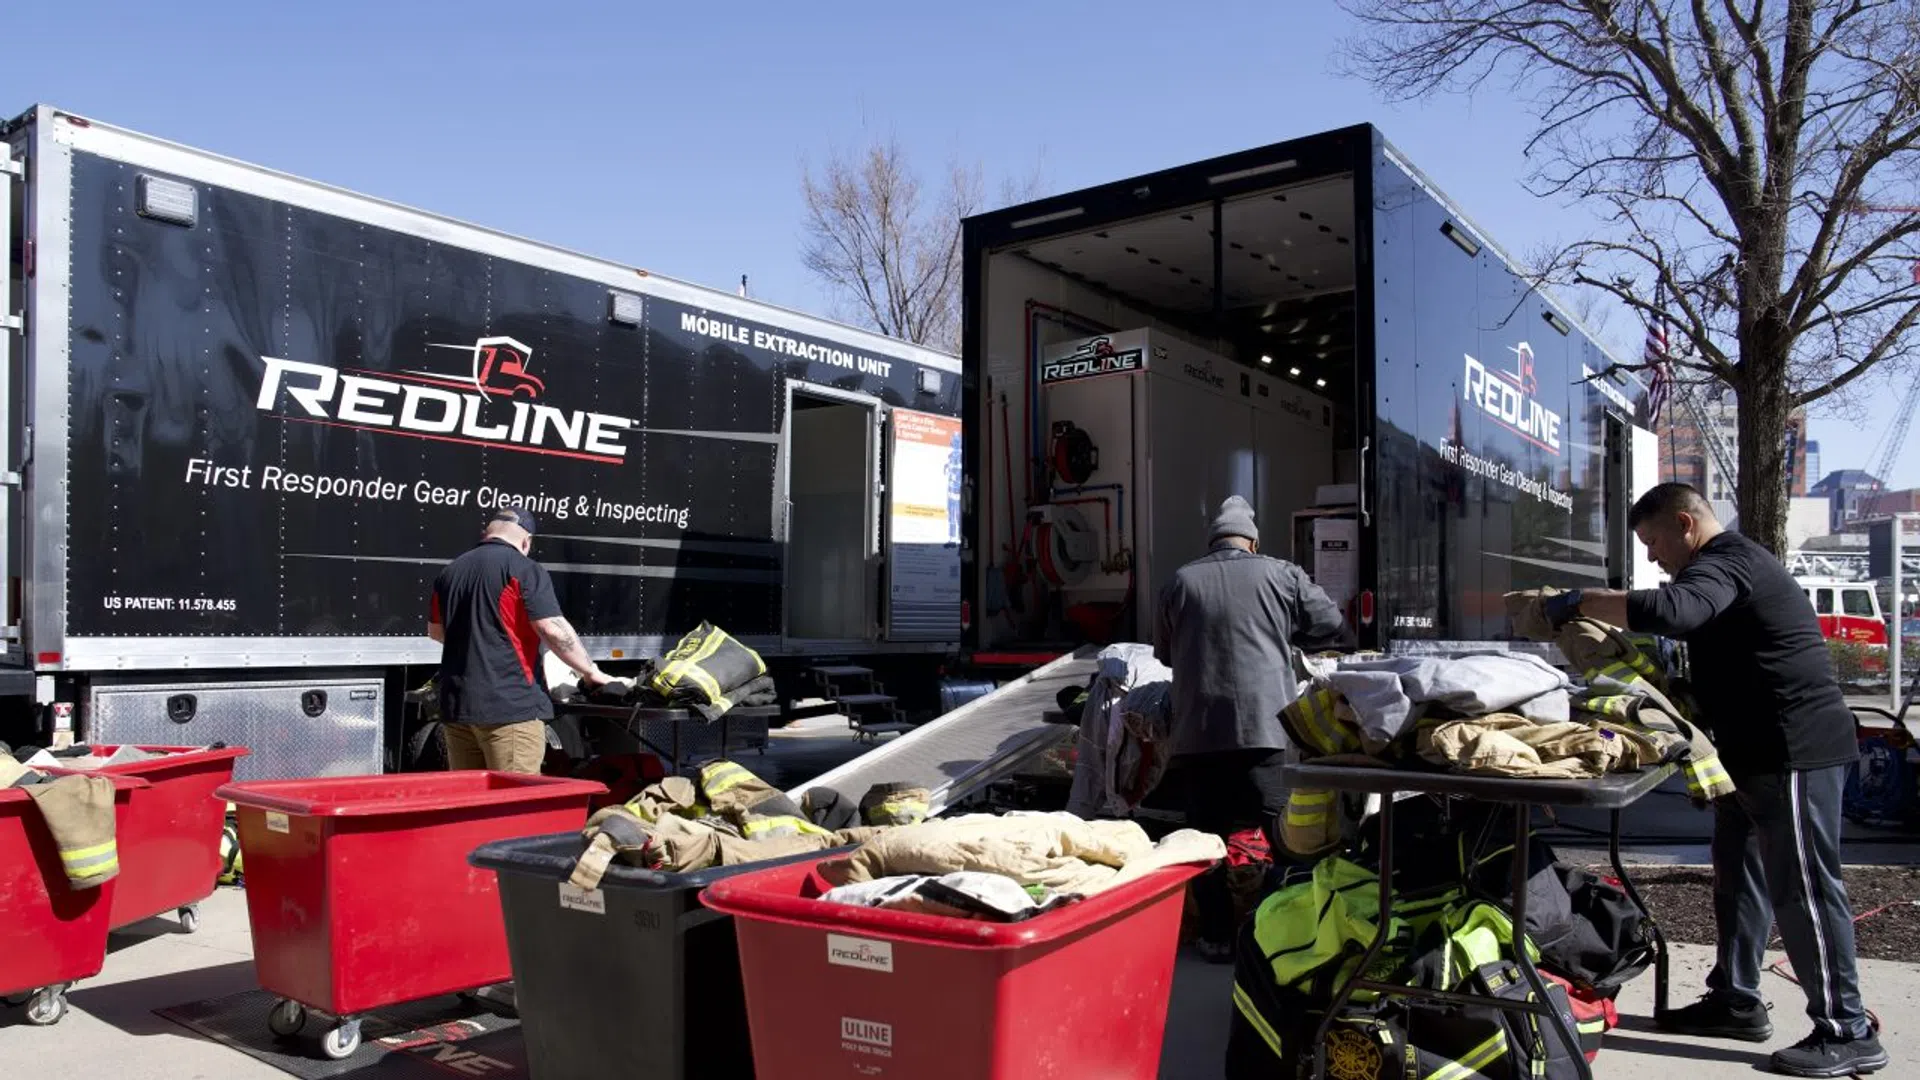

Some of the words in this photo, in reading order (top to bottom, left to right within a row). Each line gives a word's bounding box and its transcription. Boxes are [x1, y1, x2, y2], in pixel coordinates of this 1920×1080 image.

[681, 312, 749, 345] MOBILE
[754, 331, 853, 369] EXTRACTION
[857, 355, 892, 378] UNIT
[1044, 353, 1137, 379] REDLINE
[257, 355, 631, 455] REDLINE
[1463, 353, 1561, 449] REDLINE
[185, 458, 251, 488] First
[261, 465, 407, 500] Responder
[414, 480, 471, 506] Gear
[477, 486, 570, 519] Cleaning
[575, 495, 590, 517] &
[596, 498, 689, 529] Inspecting
[1440, 437, 1458, 465] First
[1460, 446, 1499, 479] Responder
[1500, 463, 1517, 487] Gear
[1516, 471, 1542, 502] Cleaning
[1548, 485, 1573, 515] Inspecting
[103, 597, 122, 609] US
[124, 597, 176, 610] PATENT:
[178, 598, 237, 611] 11.578.455
[832, 948, 889, 965] REDLINE
[845, 1021, 890, 1042] ULINE
